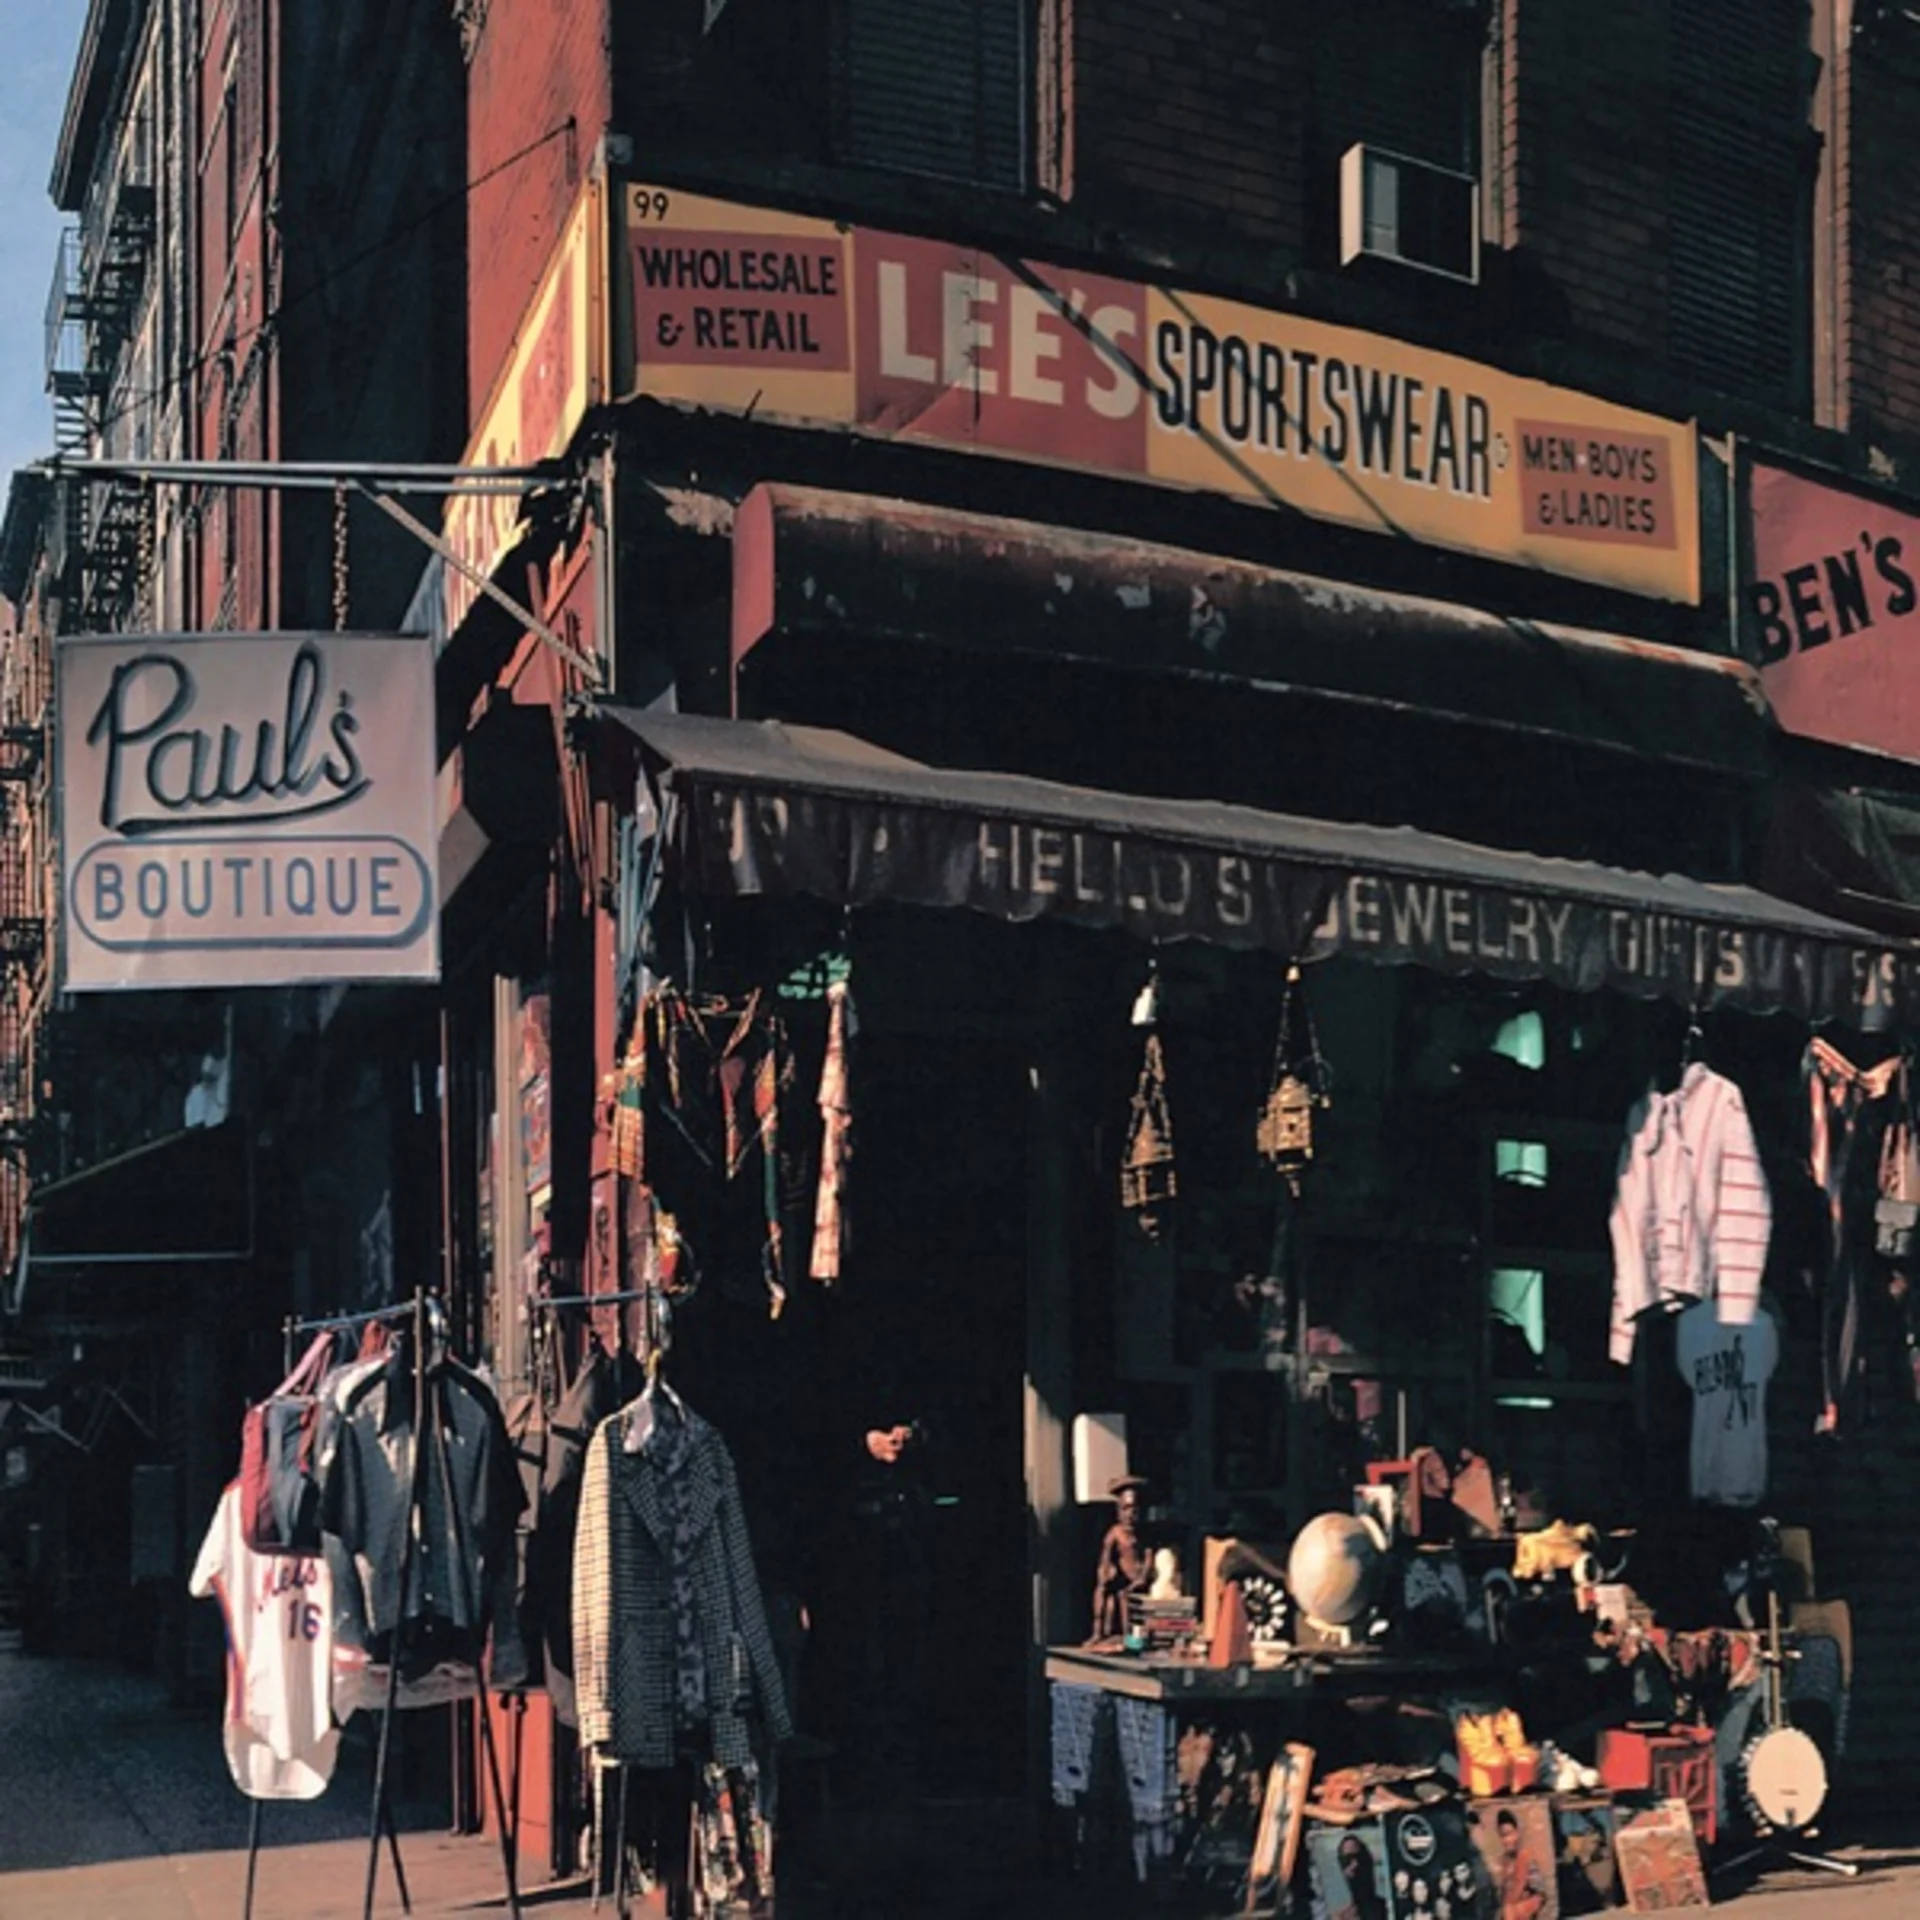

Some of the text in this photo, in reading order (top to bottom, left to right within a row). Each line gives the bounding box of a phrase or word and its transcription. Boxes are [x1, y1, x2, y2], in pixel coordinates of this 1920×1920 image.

[634, 191, 669, 221] 99
[638, 247, 838, 295] WHOLESALE
[657, 307, 820, 352] & RETAIL
[877, 260, 1493, 503] LEE'S SPORTSWEAR
[1523, 434, 1657, 484] MEN BOYS
[1748, 530, 1916, 667] BEN'S
[94, 857, 401, 921] BOUTIQUE
[288, 1599, 323, 1642] 16
